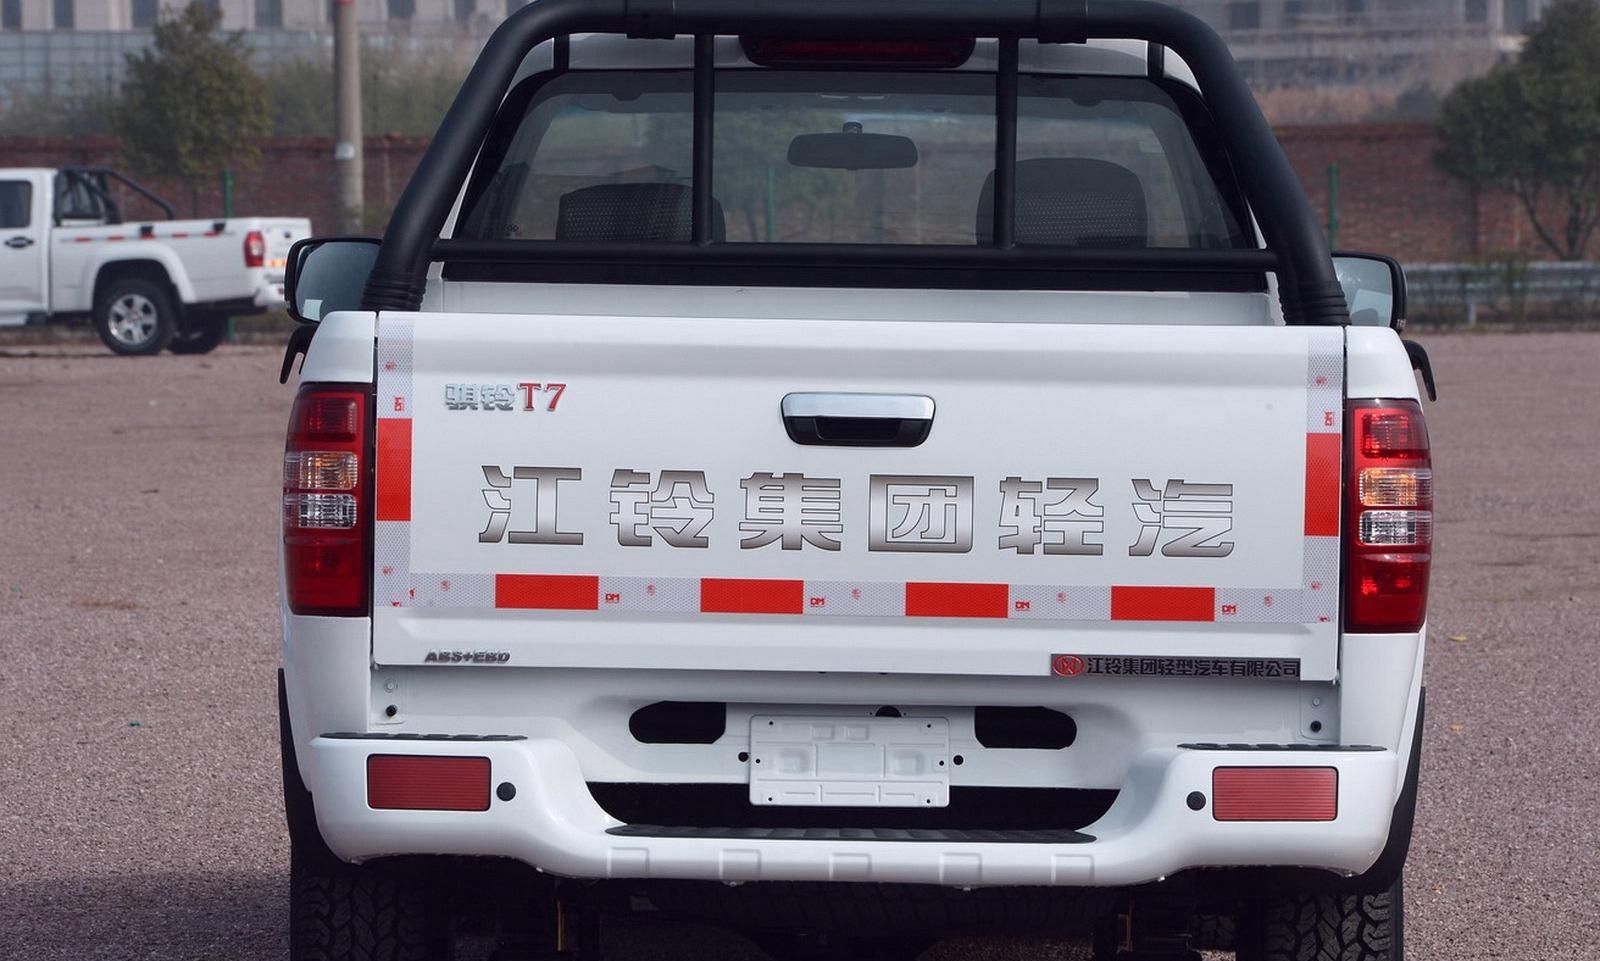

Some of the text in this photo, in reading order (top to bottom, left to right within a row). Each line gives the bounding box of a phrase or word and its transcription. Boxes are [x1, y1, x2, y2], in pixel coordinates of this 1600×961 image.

[479, 465, 1235, 557] 江铃集团轻汽
[424, 650, 511, 664] ABS+EBD
[1086, 656, 1301, 678] 江铃集团轻型汽车有限公司
